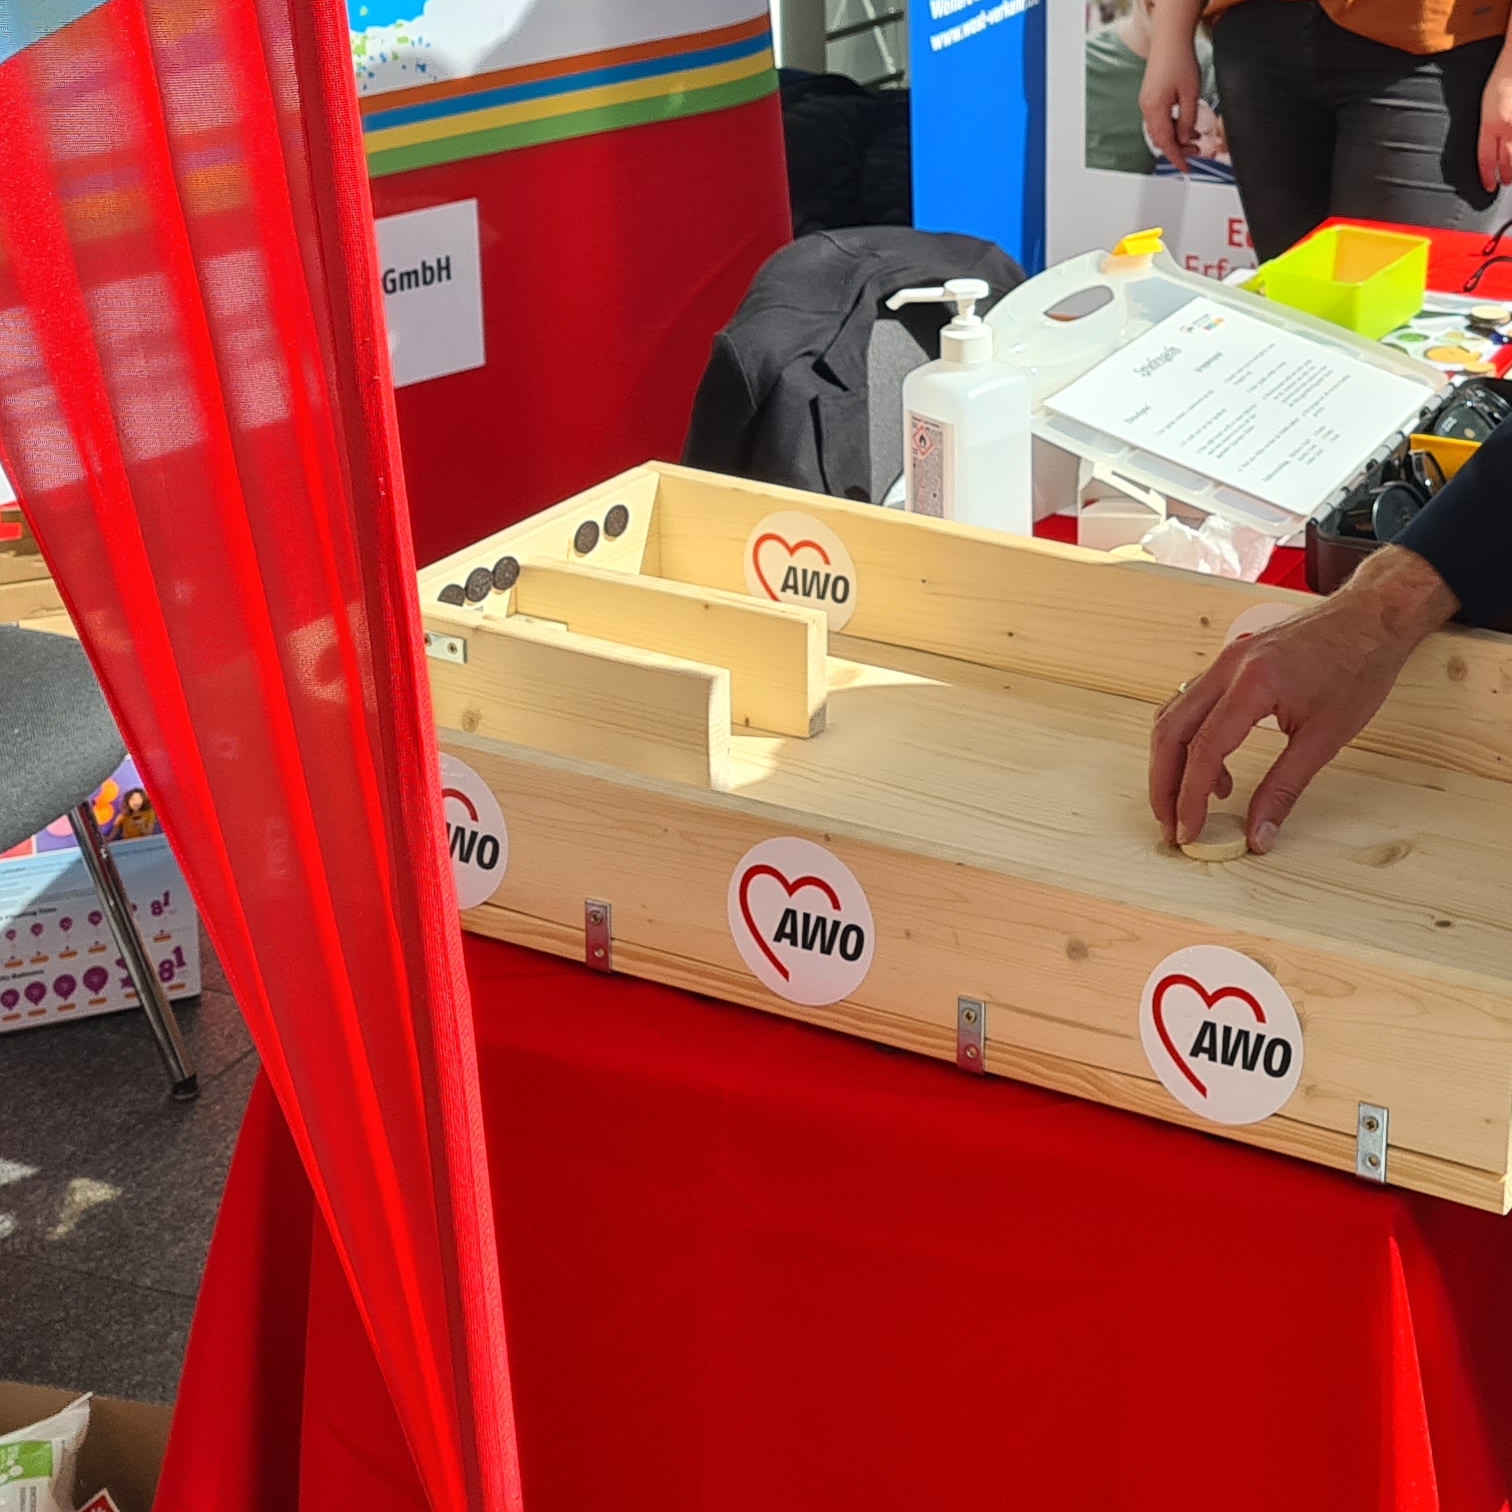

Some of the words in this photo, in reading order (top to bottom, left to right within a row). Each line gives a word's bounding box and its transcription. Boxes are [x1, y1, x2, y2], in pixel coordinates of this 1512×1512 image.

[382, 255, 452, 295] GmbH
[780, 565, 850, 605] AWO
[448, 823, 500, 871] WO
[773, 908, 866, 962] AWO
[1189, 1020, 1293, 1078] AWO
